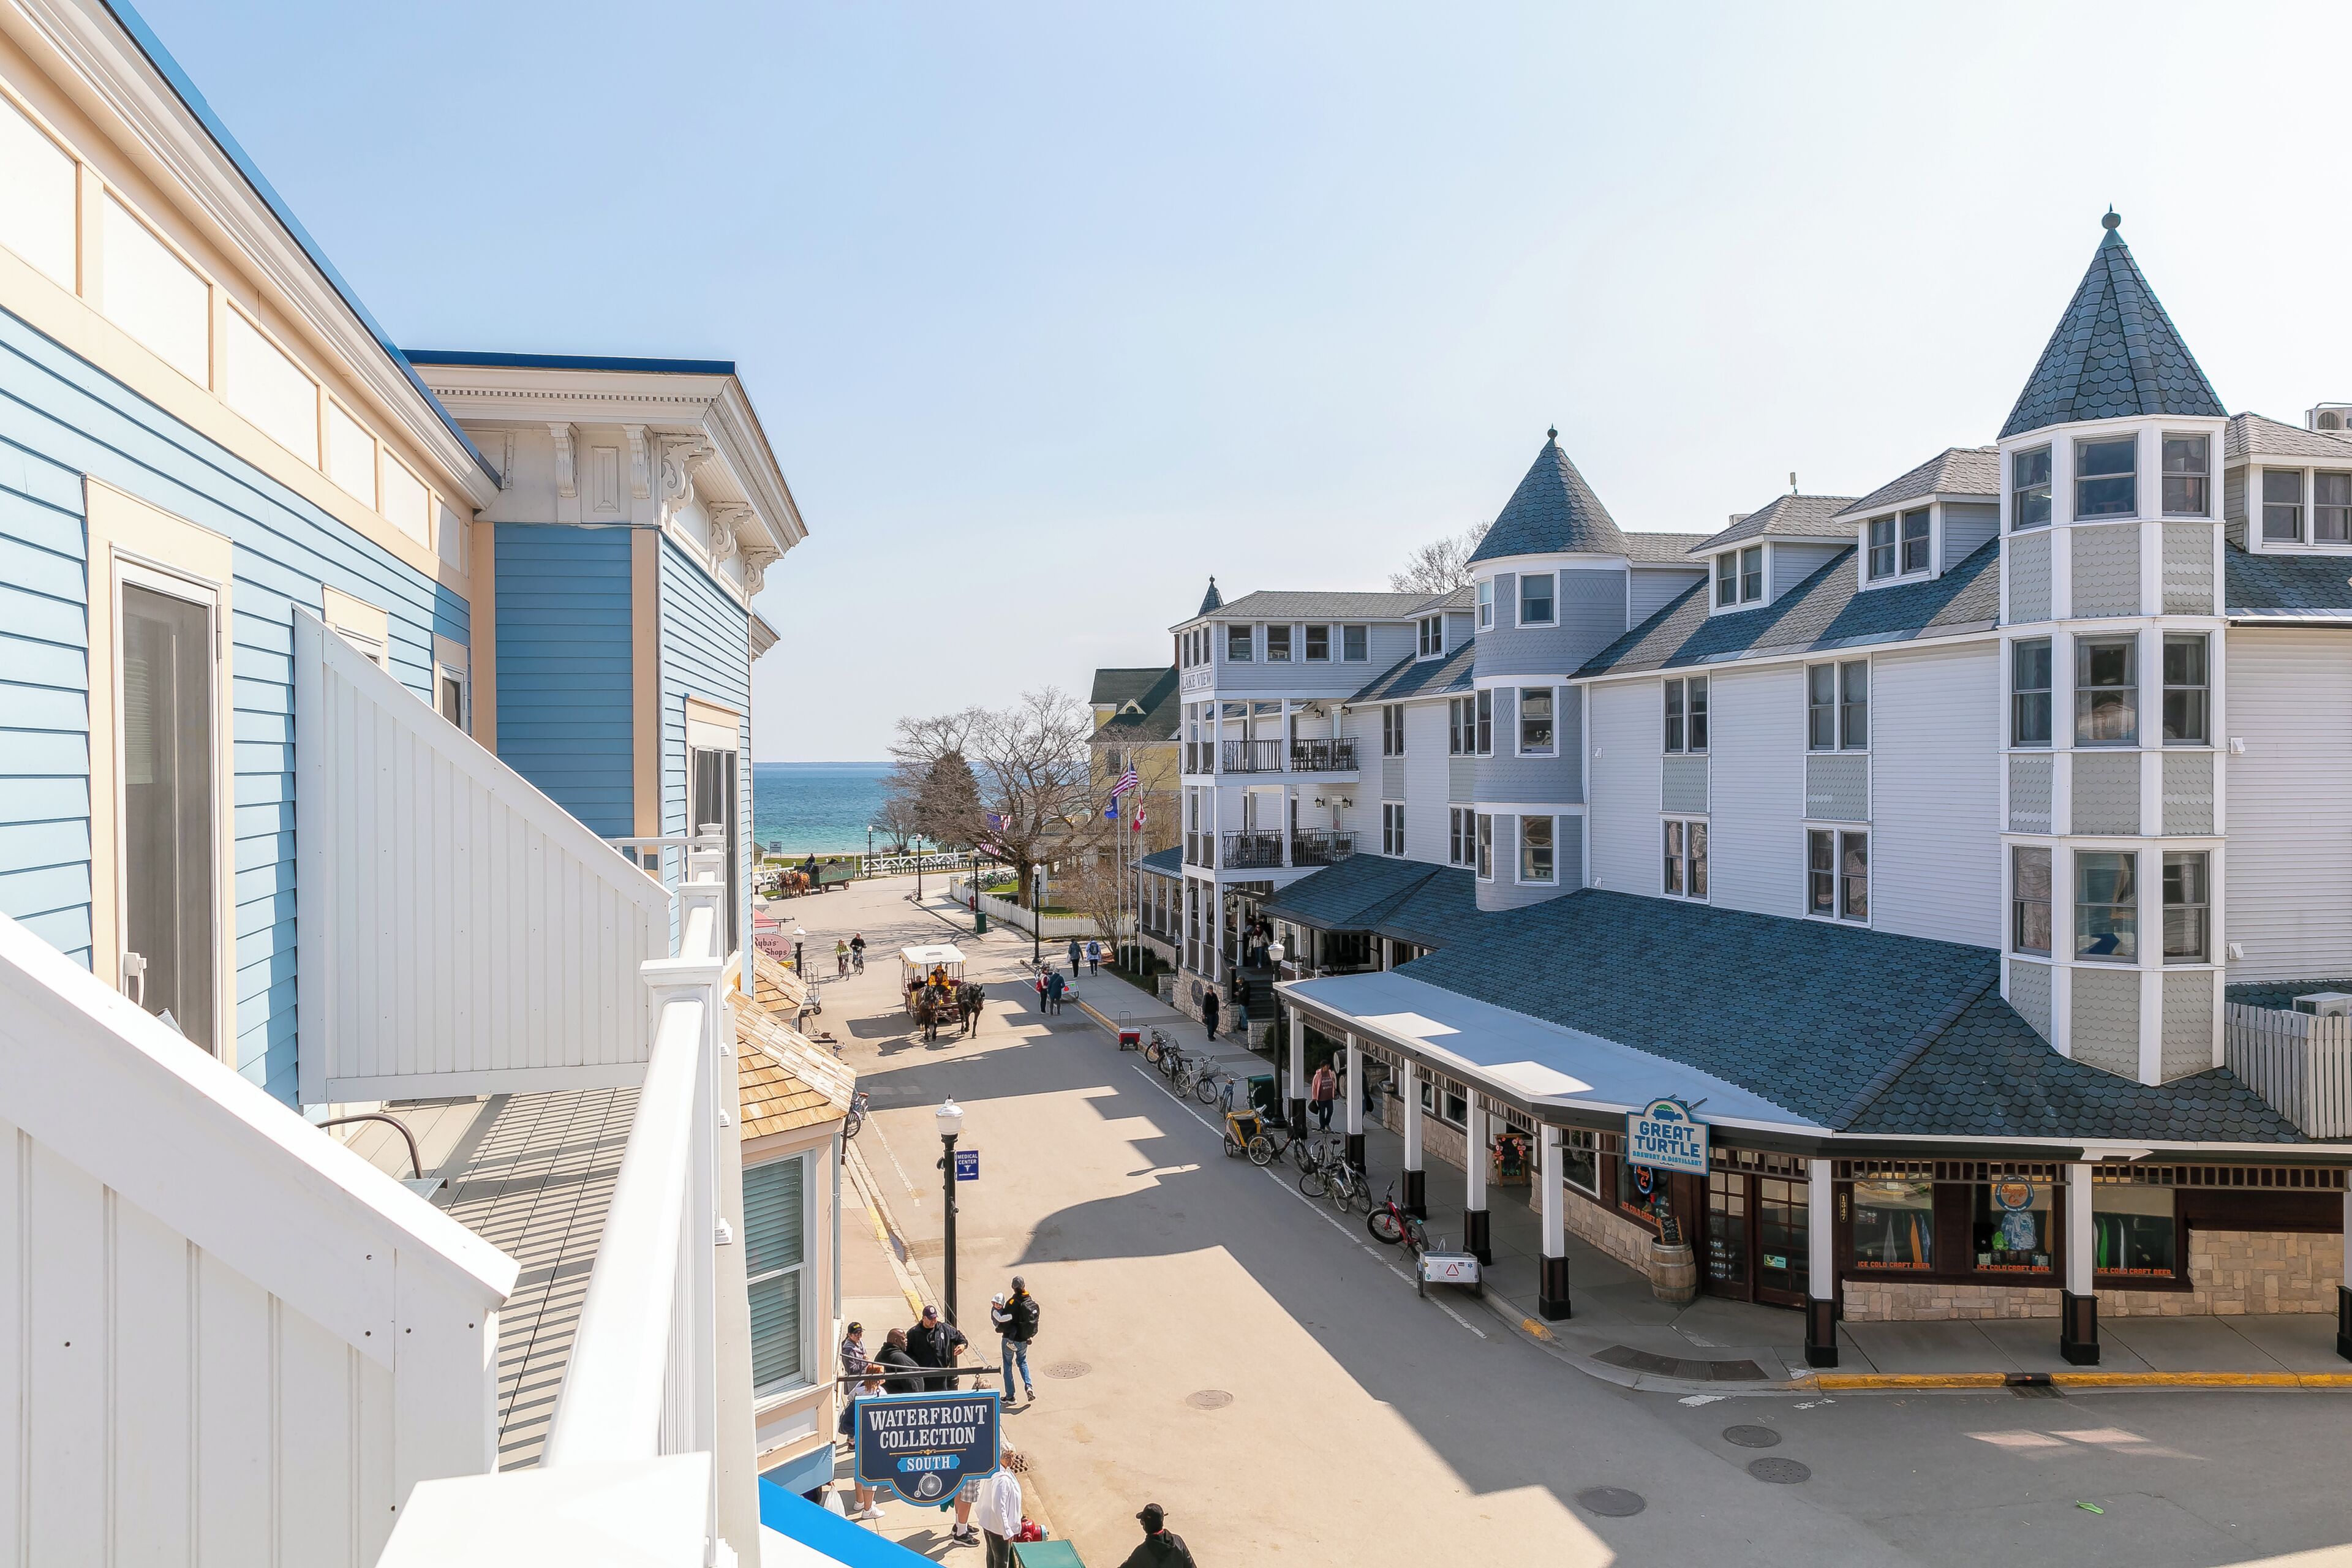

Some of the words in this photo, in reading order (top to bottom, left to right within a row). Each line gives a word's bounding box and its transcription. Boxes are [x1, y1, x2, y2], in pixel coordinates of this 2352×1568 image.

[1182, 674, 1196, 689] LAKE
[1196, 671, 1212, 685] VIEW
[764, 948, 788, 958] Shops
[1639, 1121, 1695, 1142] GREAT
[1632, 1151, 1660, 1160] BREWERY
[1634, 1135, 1700, 1158] TURTLE
[1629, 1205, 1641, 1216] COLD
[869, 1404, 987, 1431] WATERFRONT
[880, 1427, 976, 1449] COLLECTION
[907, 1456, 951, 1471] SOUTH
